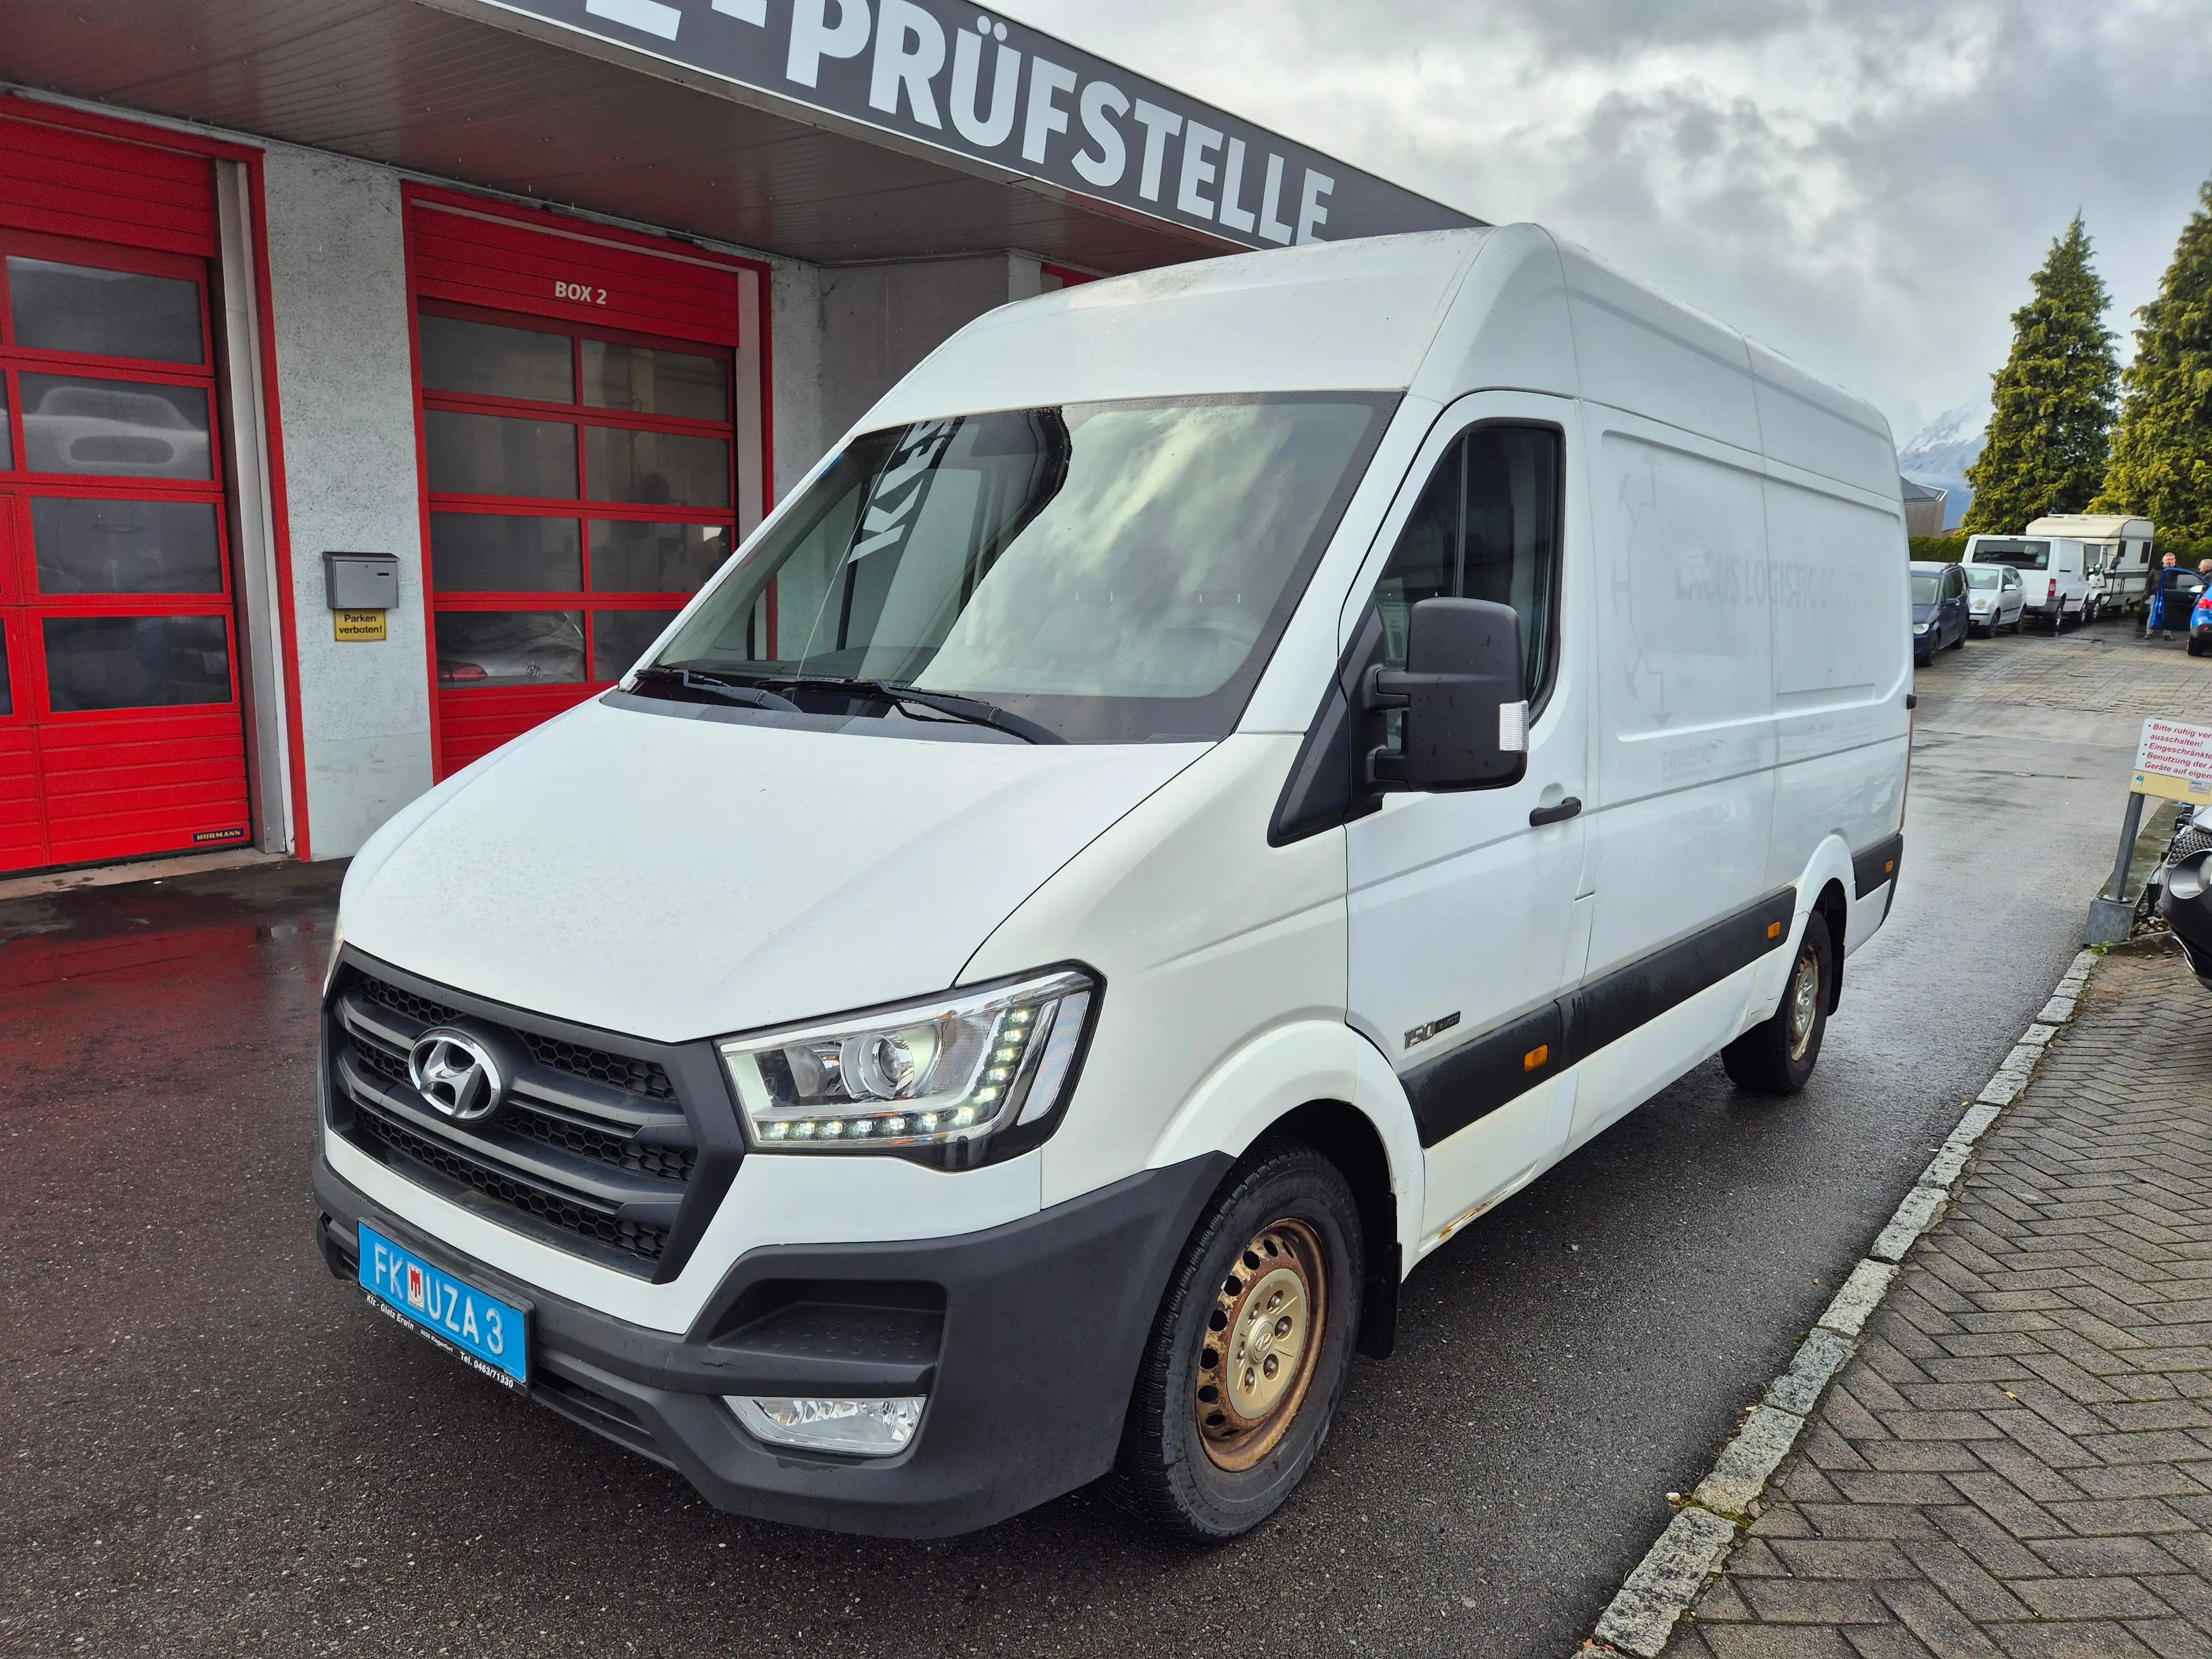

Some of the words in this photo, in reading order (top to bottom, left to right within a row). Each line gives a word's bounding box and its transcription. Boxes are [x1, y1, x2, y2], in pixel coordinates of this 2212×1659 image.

[585, 0, 1335, 247] -PRÜFSTELLE
[555, 281, 592, 302] BOX
[596, 289, 607, 305] 2
[344, 614, 377, 623] Parken
[339, 625, 383, 634] verboten!
[2153, 724, 2172, 733] Bitte
[2173, 728, 2196, 738] ruhig
[2150, 734, 2203, 748] ausschalten!
[2149, 743, 2212, 759] Eingeschränkte
[2147, 752, 2191, 767] Benutzung
[2145, 761, 2172, 772] Geräte
[2173, 767, 2188, 775] auf
[2189, 770, 2212, 780] eigen
[374, 1243, 404, 1302] FK
[426, 1272, 480, 1346] UZA
[486, 1308, 504, 1355] 3
[367, 1294, 376, 1306] Kfz
[380, 1304, 396, 1319] Glatz
[396, 1313, 414, 1331] Erwin
[460, 1351, 472, 1366] Tel.
[474, 1360, 514, 1388] 0463/71330
